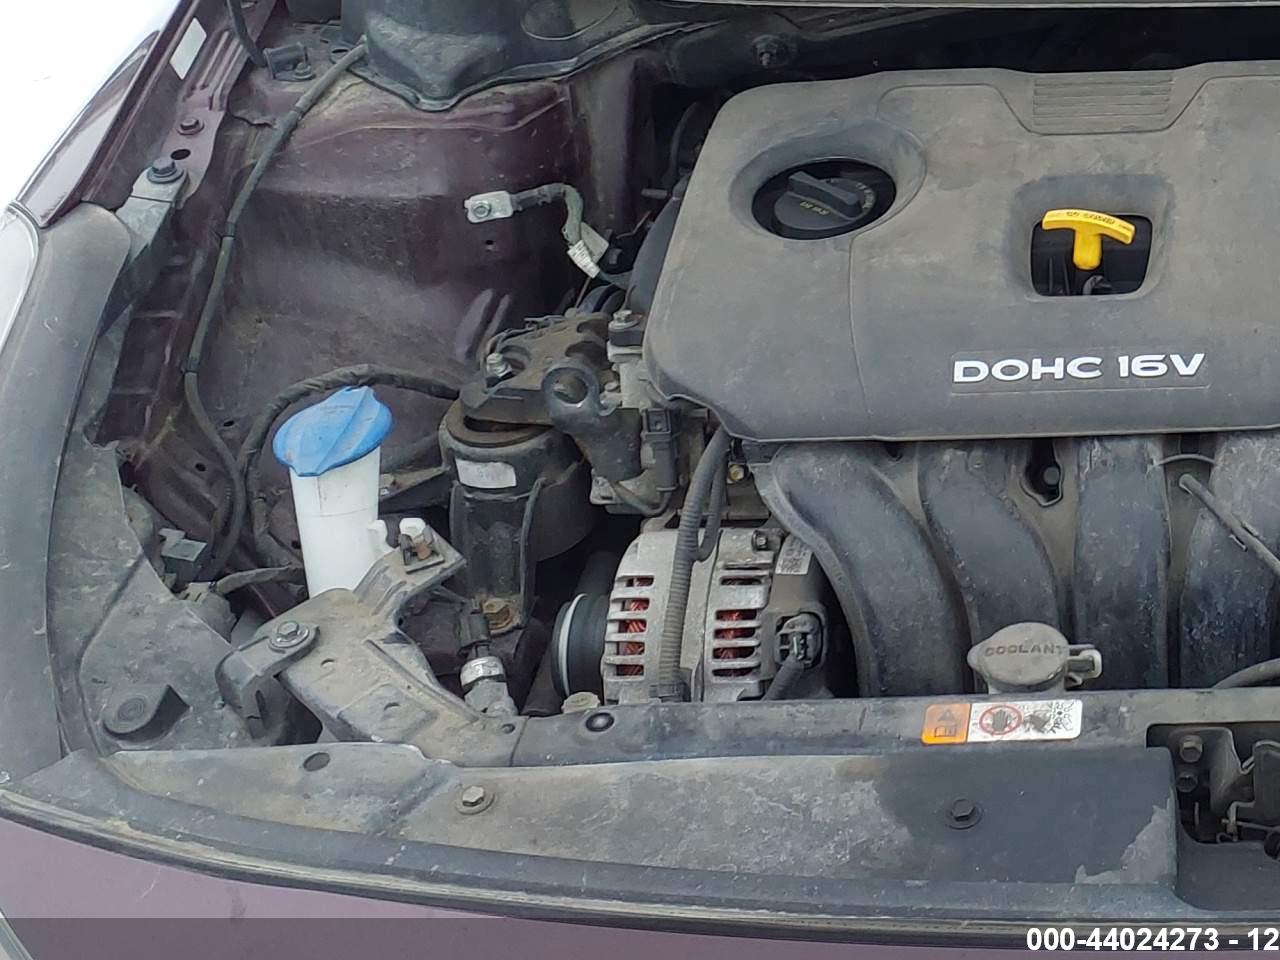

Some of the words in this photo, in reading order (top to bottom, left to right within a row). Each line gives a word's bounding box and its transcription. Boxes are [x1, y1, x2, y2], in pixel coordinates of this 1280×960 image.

[954, 357, 1103, 382] DOHC
[1118, 353, 1205, 378] 16V
[985, 644, 1064, 657] COOLANT
